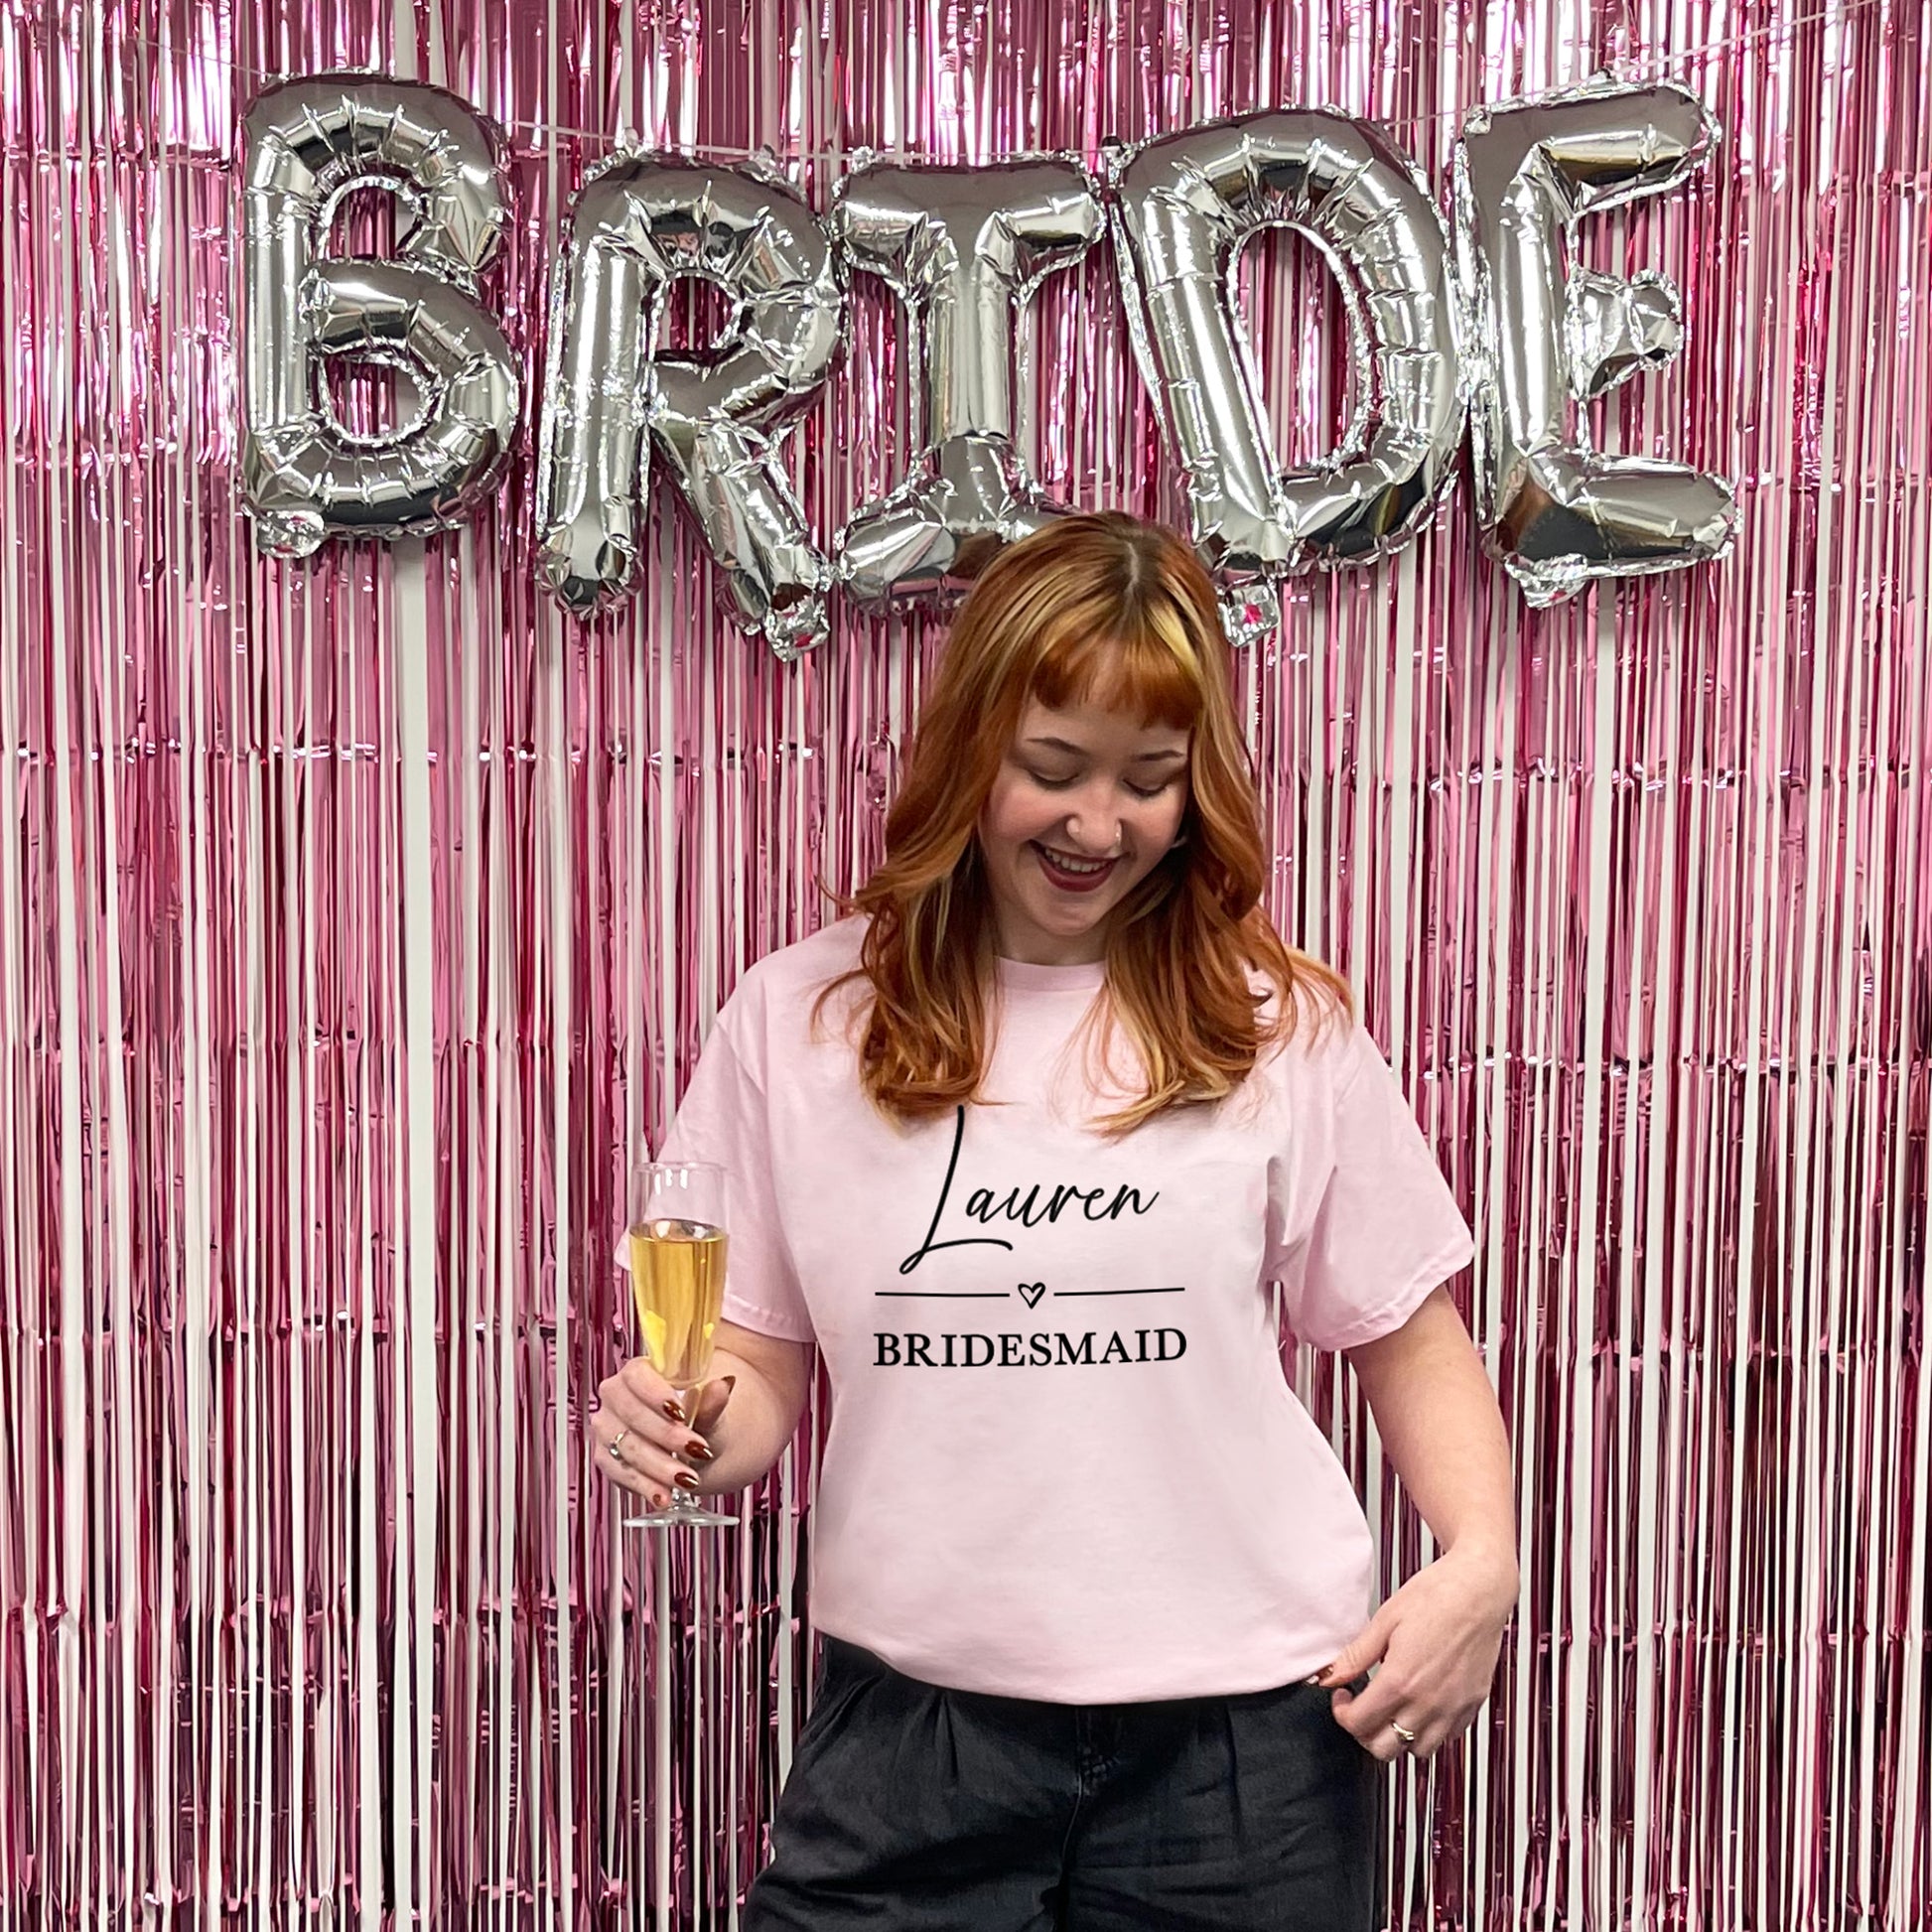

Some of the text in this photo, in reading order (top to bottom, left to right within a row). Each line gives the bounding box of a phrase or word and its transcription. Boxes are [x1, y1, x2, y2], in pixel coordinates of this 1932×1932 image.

[238, 69, 1739, 650] BRIDE
[898, 1104, 1161, 1276] Lauren
[872, 1327, 1188, 1368] BRIDESMAID
